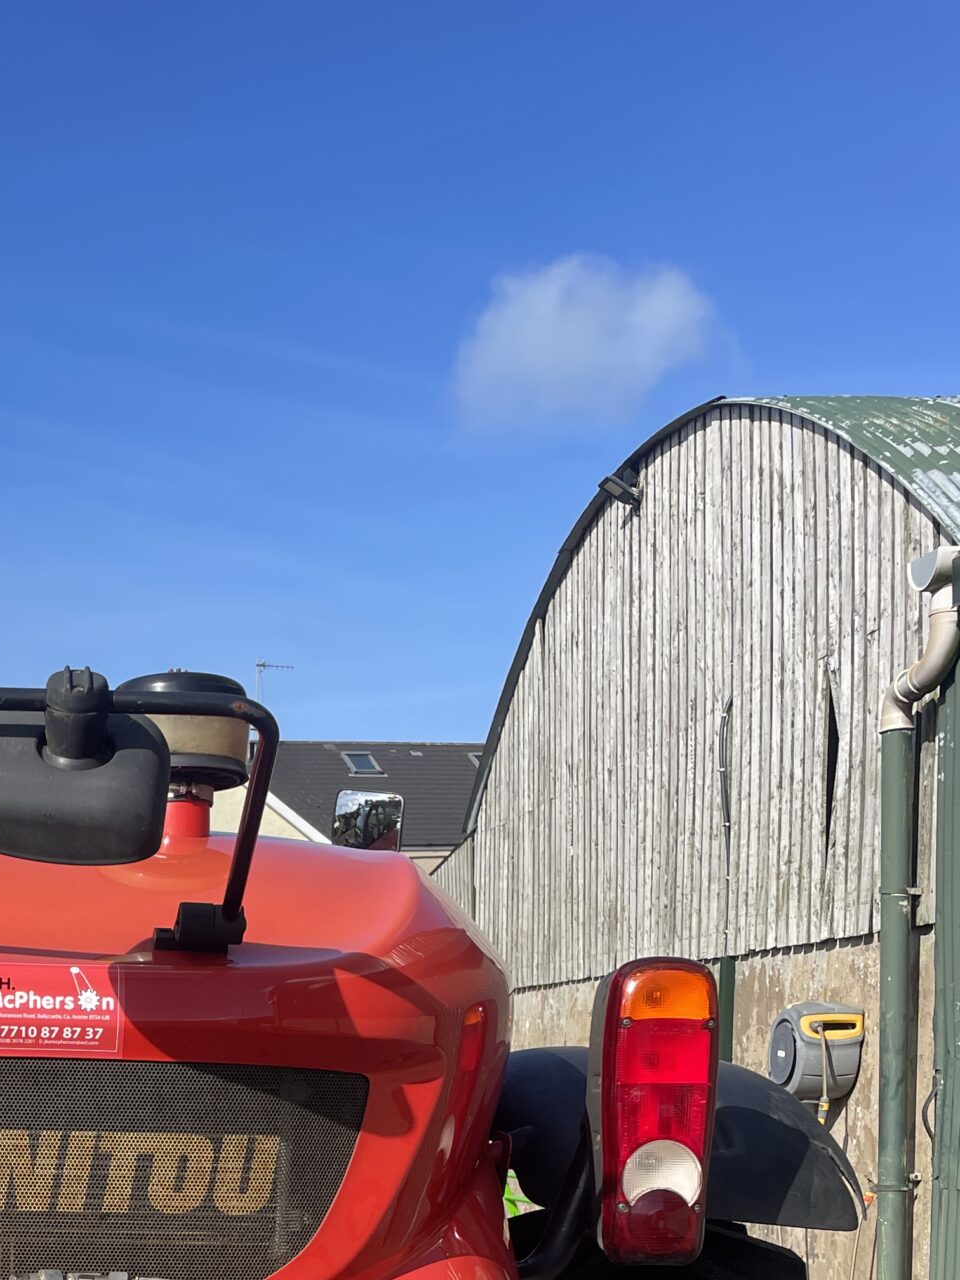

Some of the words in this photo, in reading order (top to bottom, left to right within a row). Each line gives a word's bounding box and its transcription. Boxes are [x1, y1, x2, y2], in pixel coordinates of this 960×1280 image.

[40, 1026, 59, 1039] 87
[62, 1027, 82, 1039] 87
[84, 1027, 104, 1040] 37
